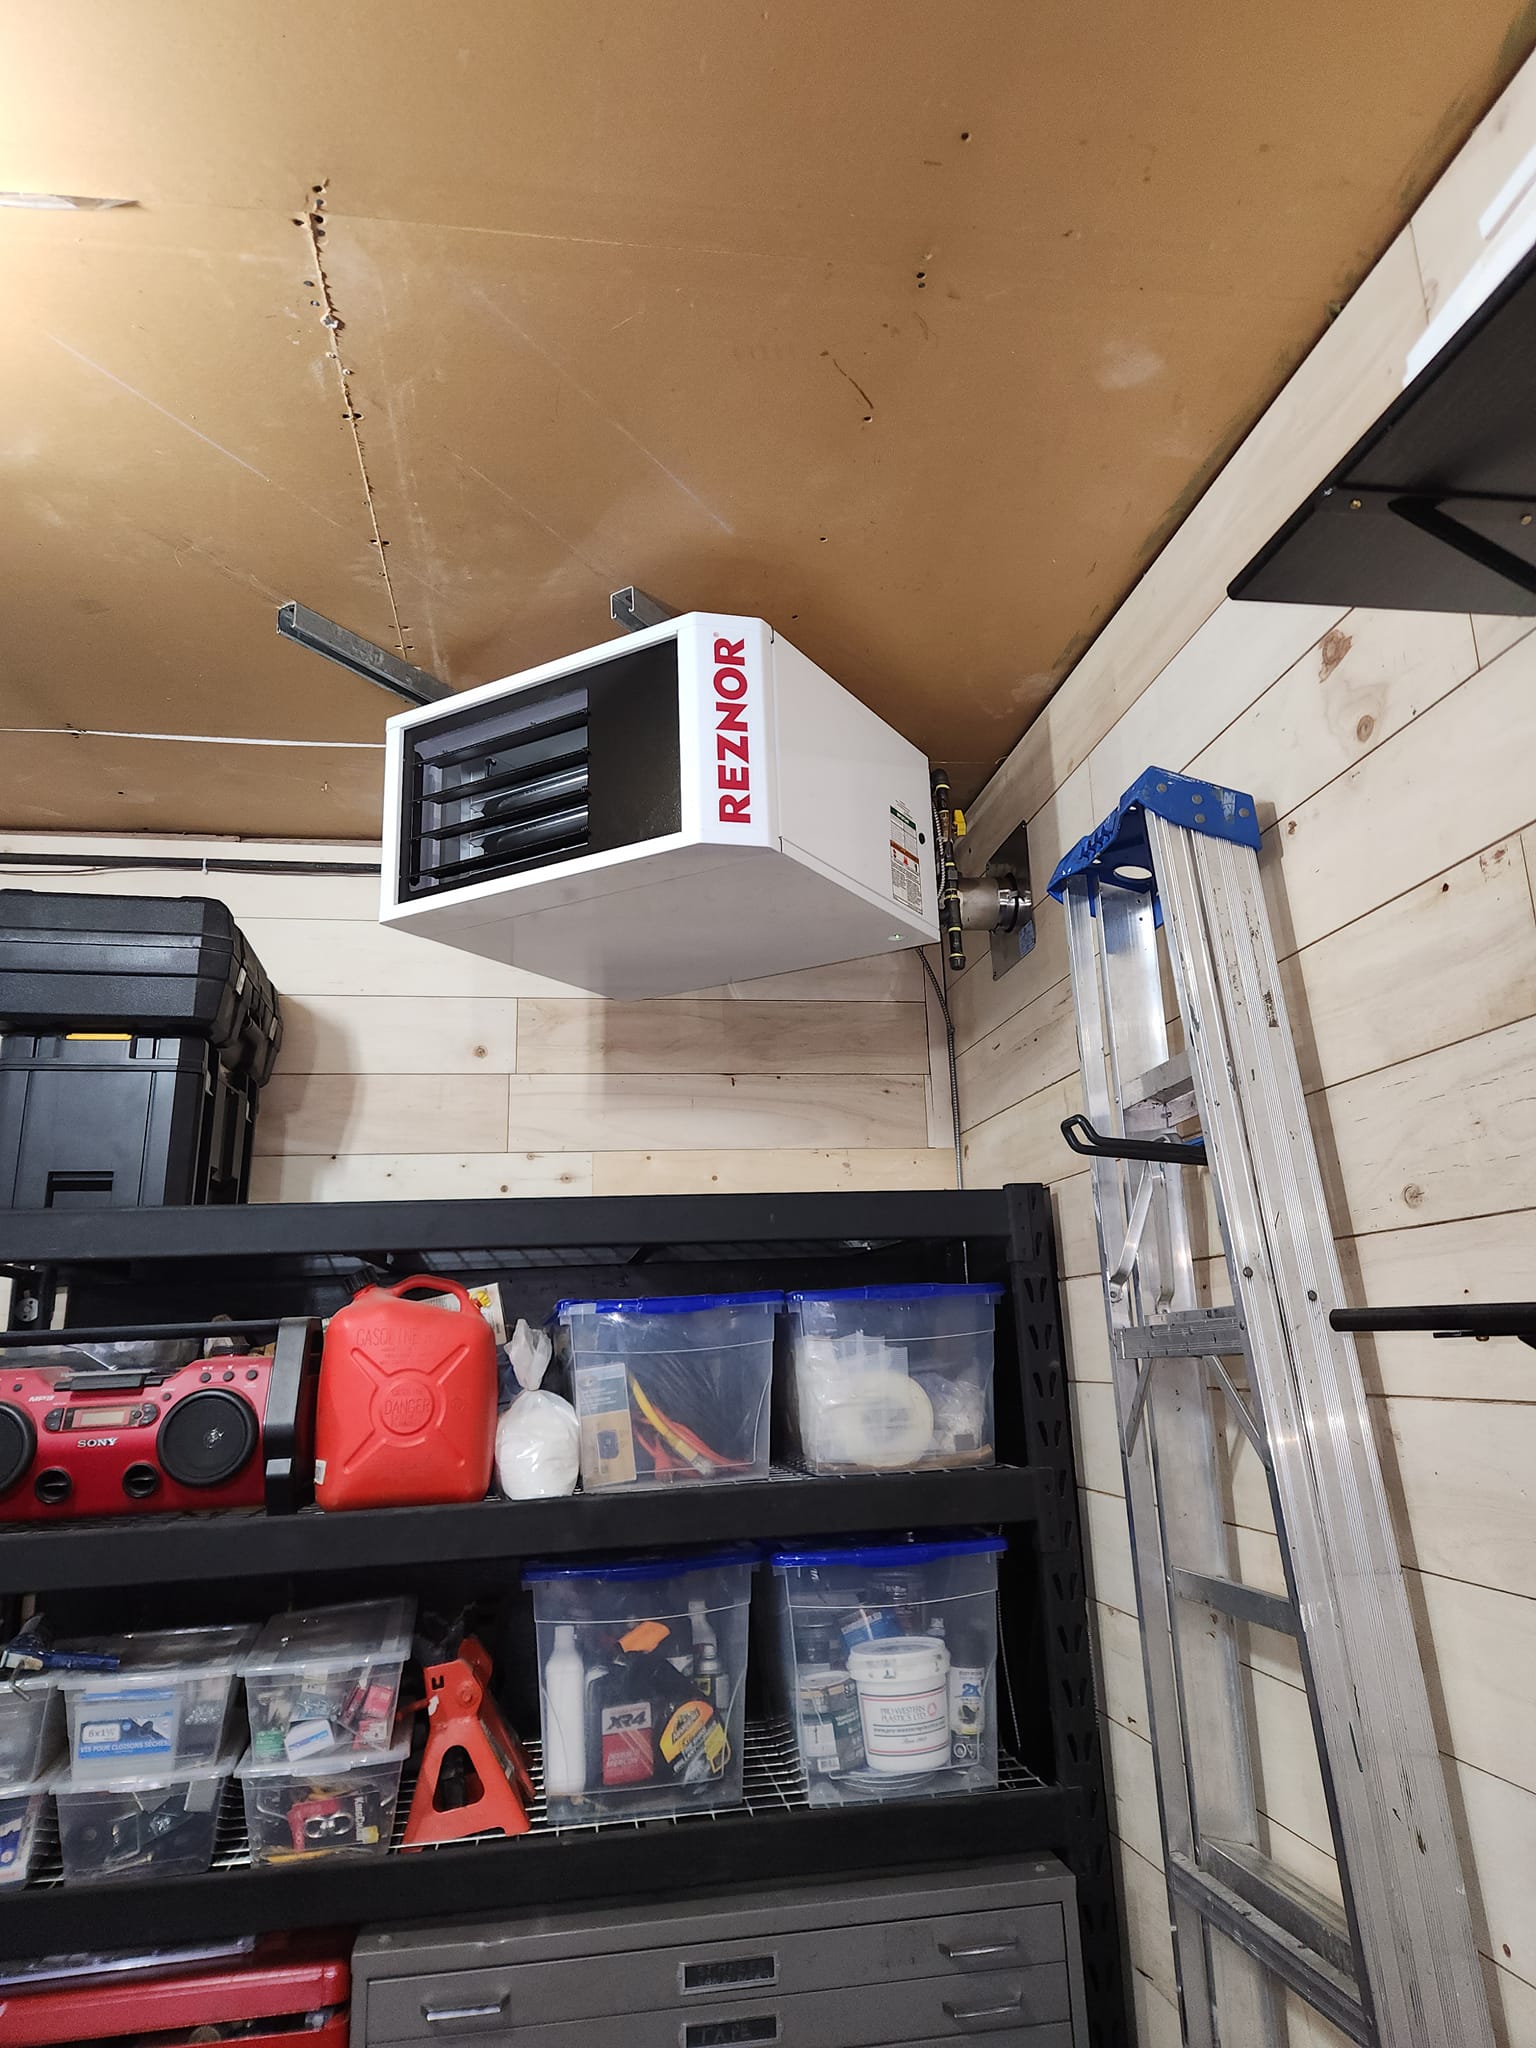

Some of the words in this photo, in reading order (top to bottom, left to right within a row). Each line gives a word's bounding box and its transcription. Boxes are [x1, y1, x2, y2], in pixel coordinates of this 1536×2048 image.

[713, 637, 751, 824] REZNOR
[384, 1399, 431, 1415] DANGER
[77, 1437, 118, 1448] SONY
[607, 1710, 647, 1730] XR4
